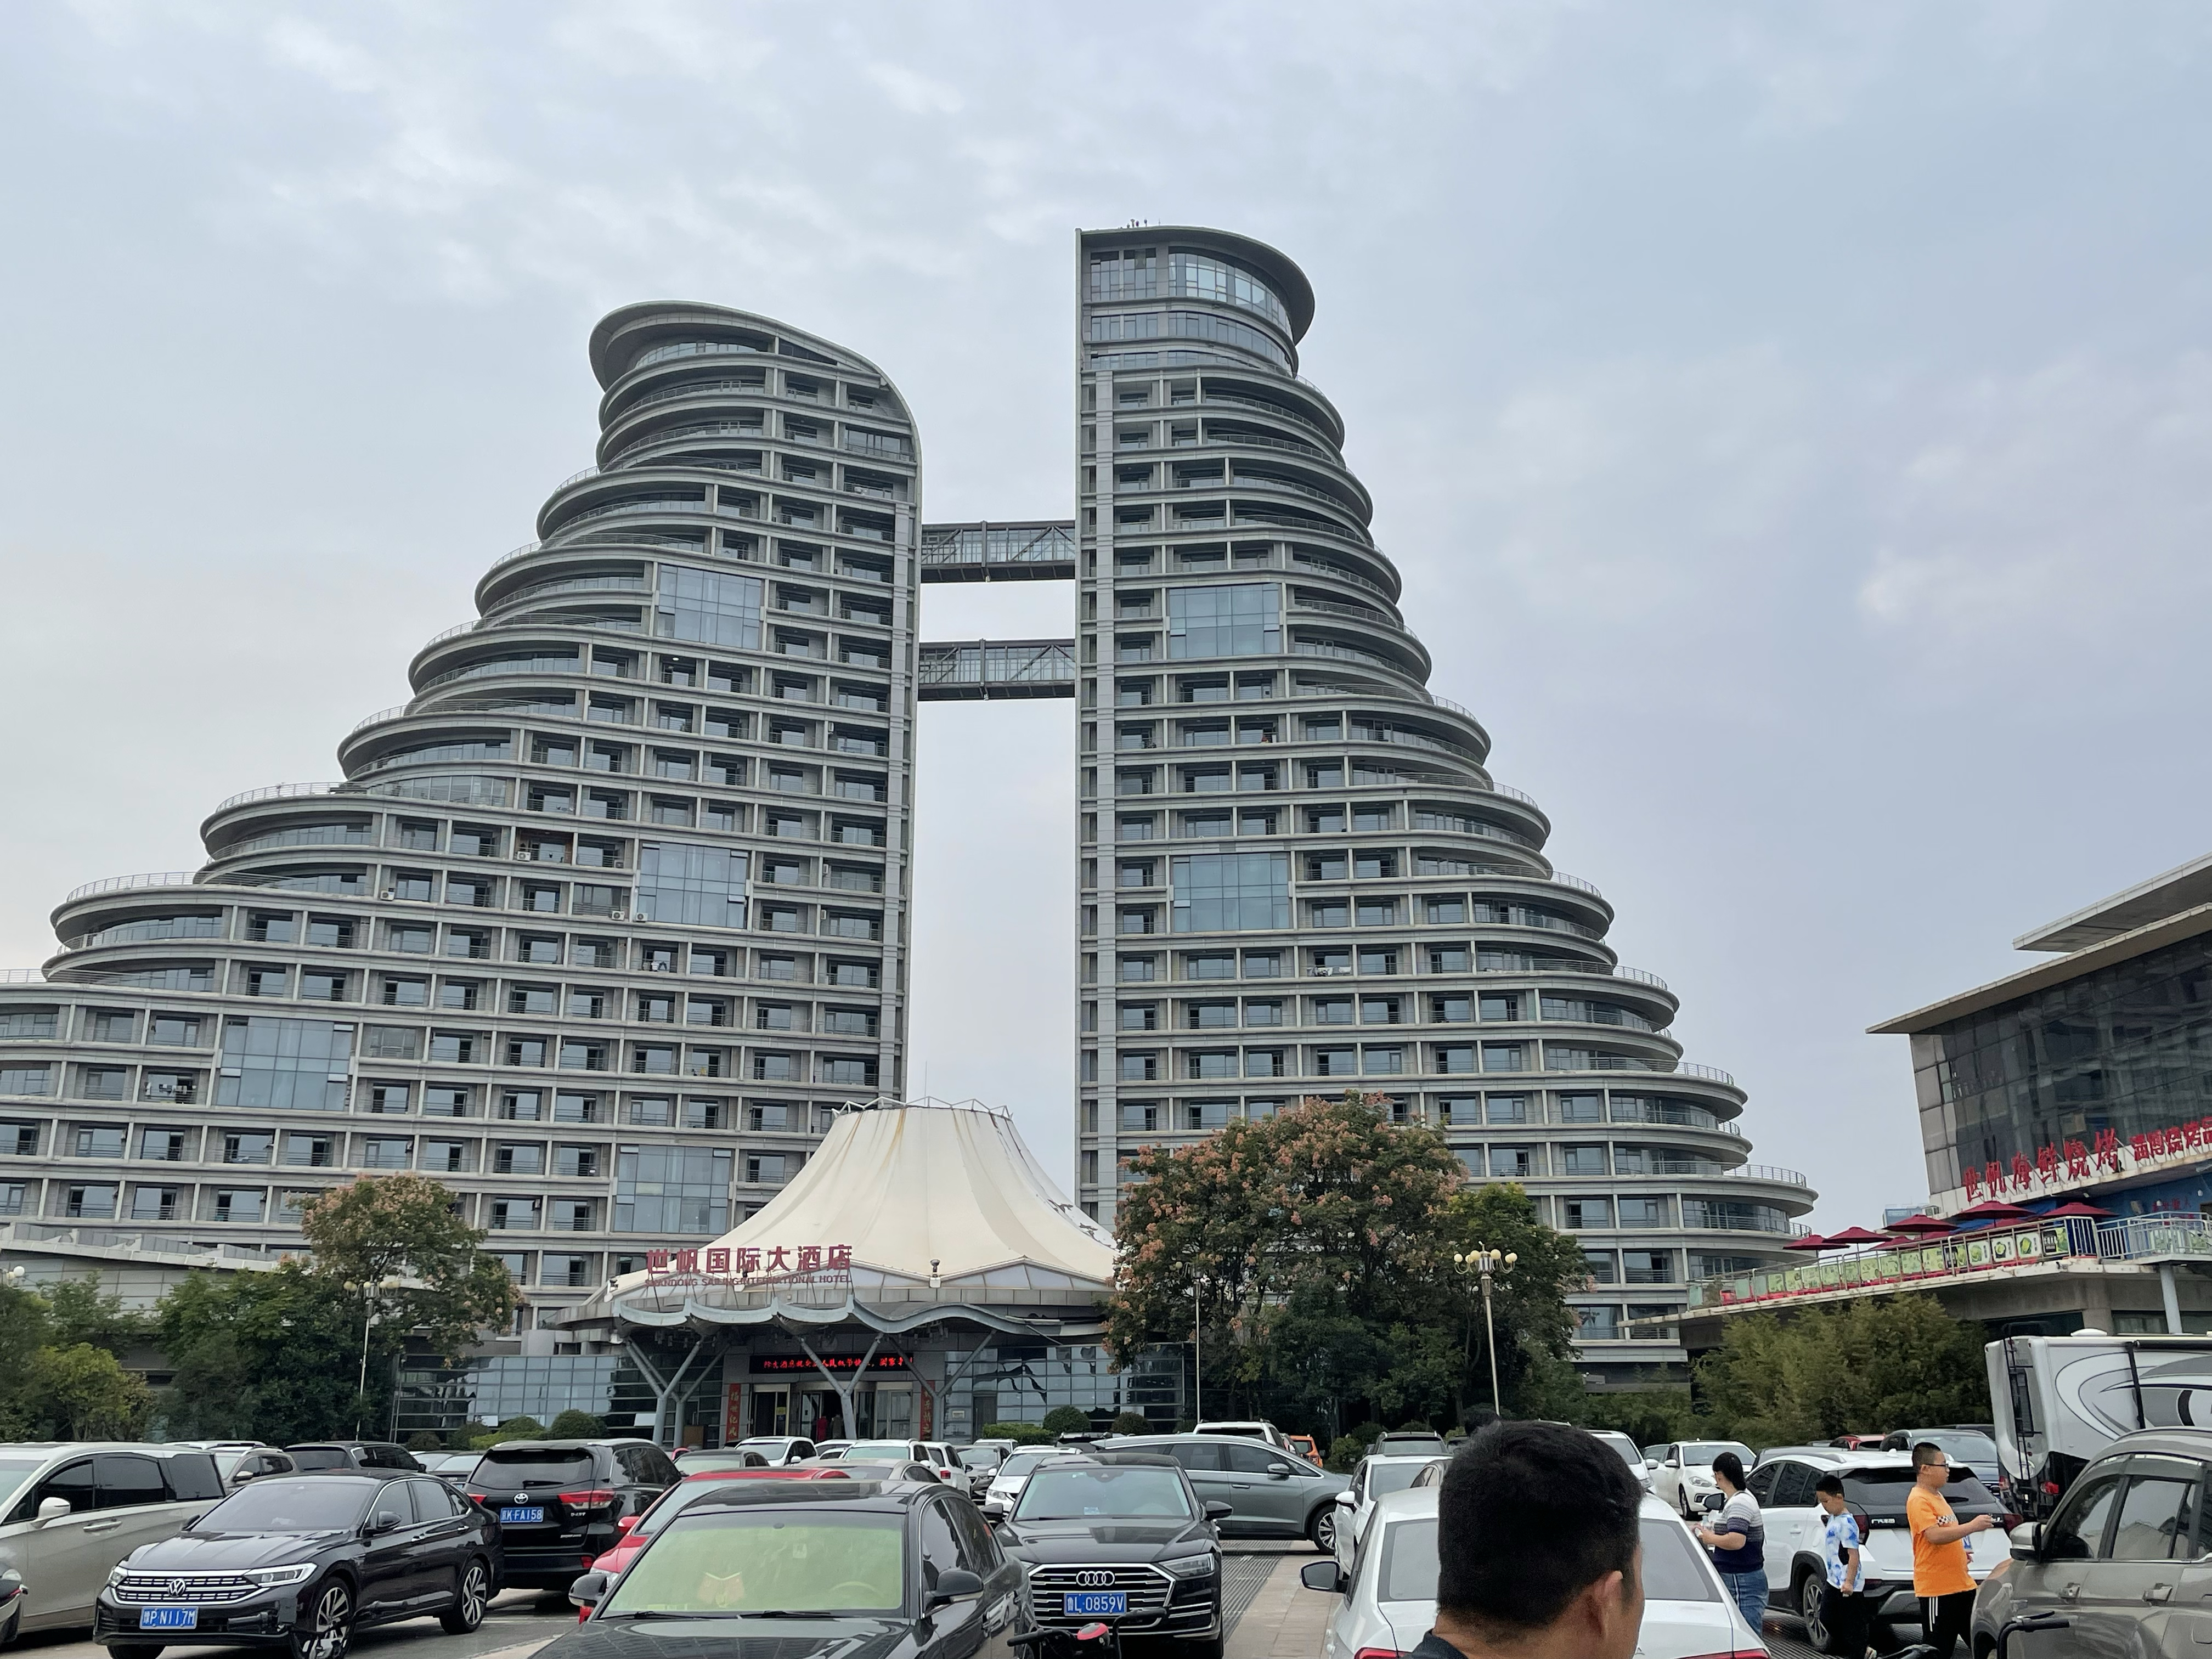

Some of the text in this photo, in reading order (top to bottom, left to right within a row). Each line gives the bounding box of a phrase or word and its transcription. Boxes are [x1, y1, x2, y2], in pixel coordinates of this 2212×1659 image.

[1964, 1128, 2118, 1203] 世帆海鲜烧烤
[646, 1244, 852, 1274] 世帆国际大酒店
[819, 1274, 852, 1283] HOTEL
